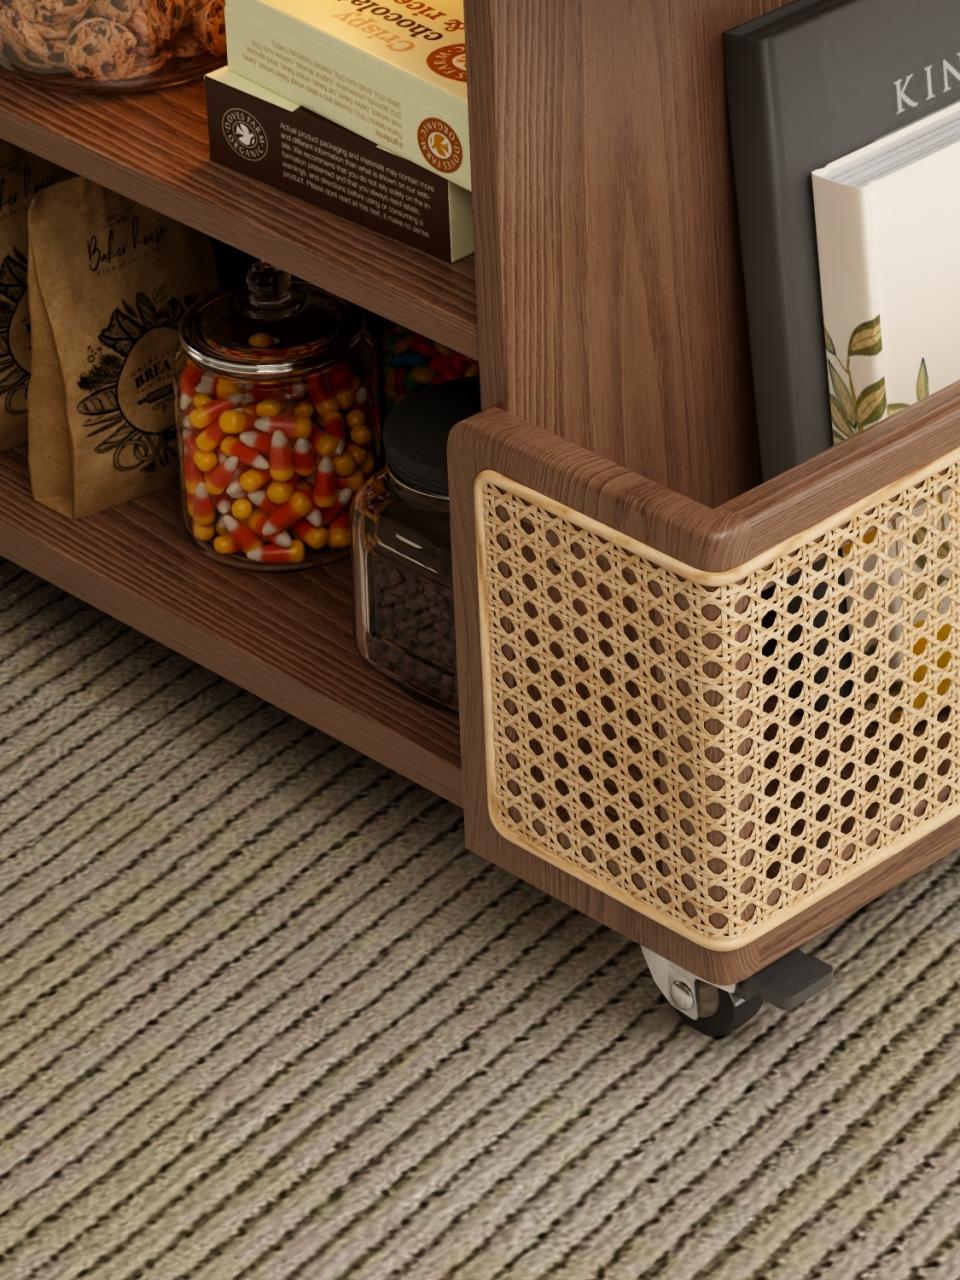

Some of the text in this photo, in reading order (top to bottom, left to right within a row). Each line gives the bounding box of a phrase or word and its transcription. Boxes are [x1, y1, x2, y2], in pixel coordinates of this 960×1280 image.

[331, 10, 416, 52] Crispy
[443, 19, 465, 32] &
[224, 111, 265, 144] DOVES FARM
[420, 119, 455, 138] ORGANIC
[227, 134, 264, 158] ORGANIC
[442, 145, 461, 170] DOVES
[134, 359, 172, 388] BREA
